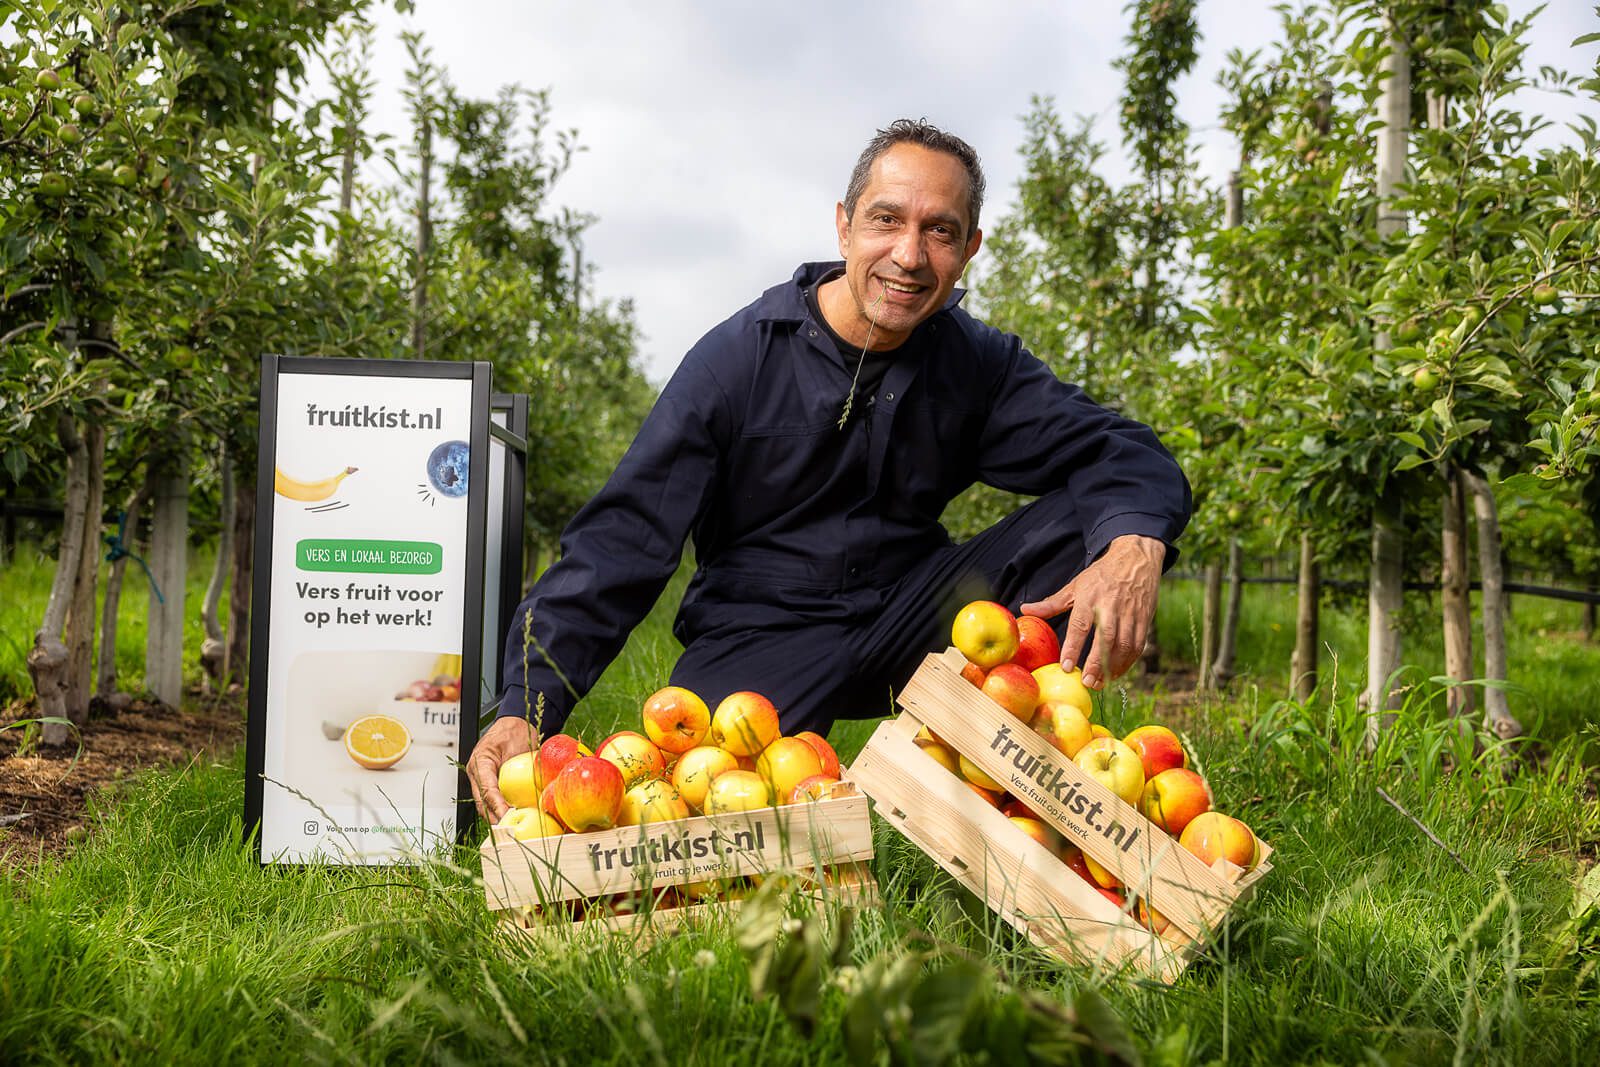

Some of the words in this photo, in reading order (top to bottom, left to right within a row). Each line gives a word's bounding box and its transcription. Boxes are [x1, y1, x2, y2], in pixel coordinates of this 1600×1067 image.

[306, 403, 442, 430] fruitkist.nl
[306, 548, 330, 562] VERS
[334, 549, 347, 562] EN
[351, 550, 386, 564] LOKAAL
[390, 550, 433, 565] BEZORGD
[296, 582, 340, 599] Vers
[345, 583, 391, 600] fruit
[396, 589, 443, 602] voor
[304, 611, 330, 628] op
[336, 606, 370, 625] het
[375, 608, 432, 627] werk!
[424, 706, 460, 726] frui
[990, 723, 1142, 854] fruitkist.nl
[1010, 773, 1030, 793] Vers
[1028, 788, 1048, 807] fruit
[1046, 804, 1059, 817] op
[1055, 811, 1067, 824] je
[1066, 819, 1090, 841] werk
[359, 826, 370, 835] op
[589, 821, 765, 872] fruitkist.nl
[692, 862, 702, 876] je
